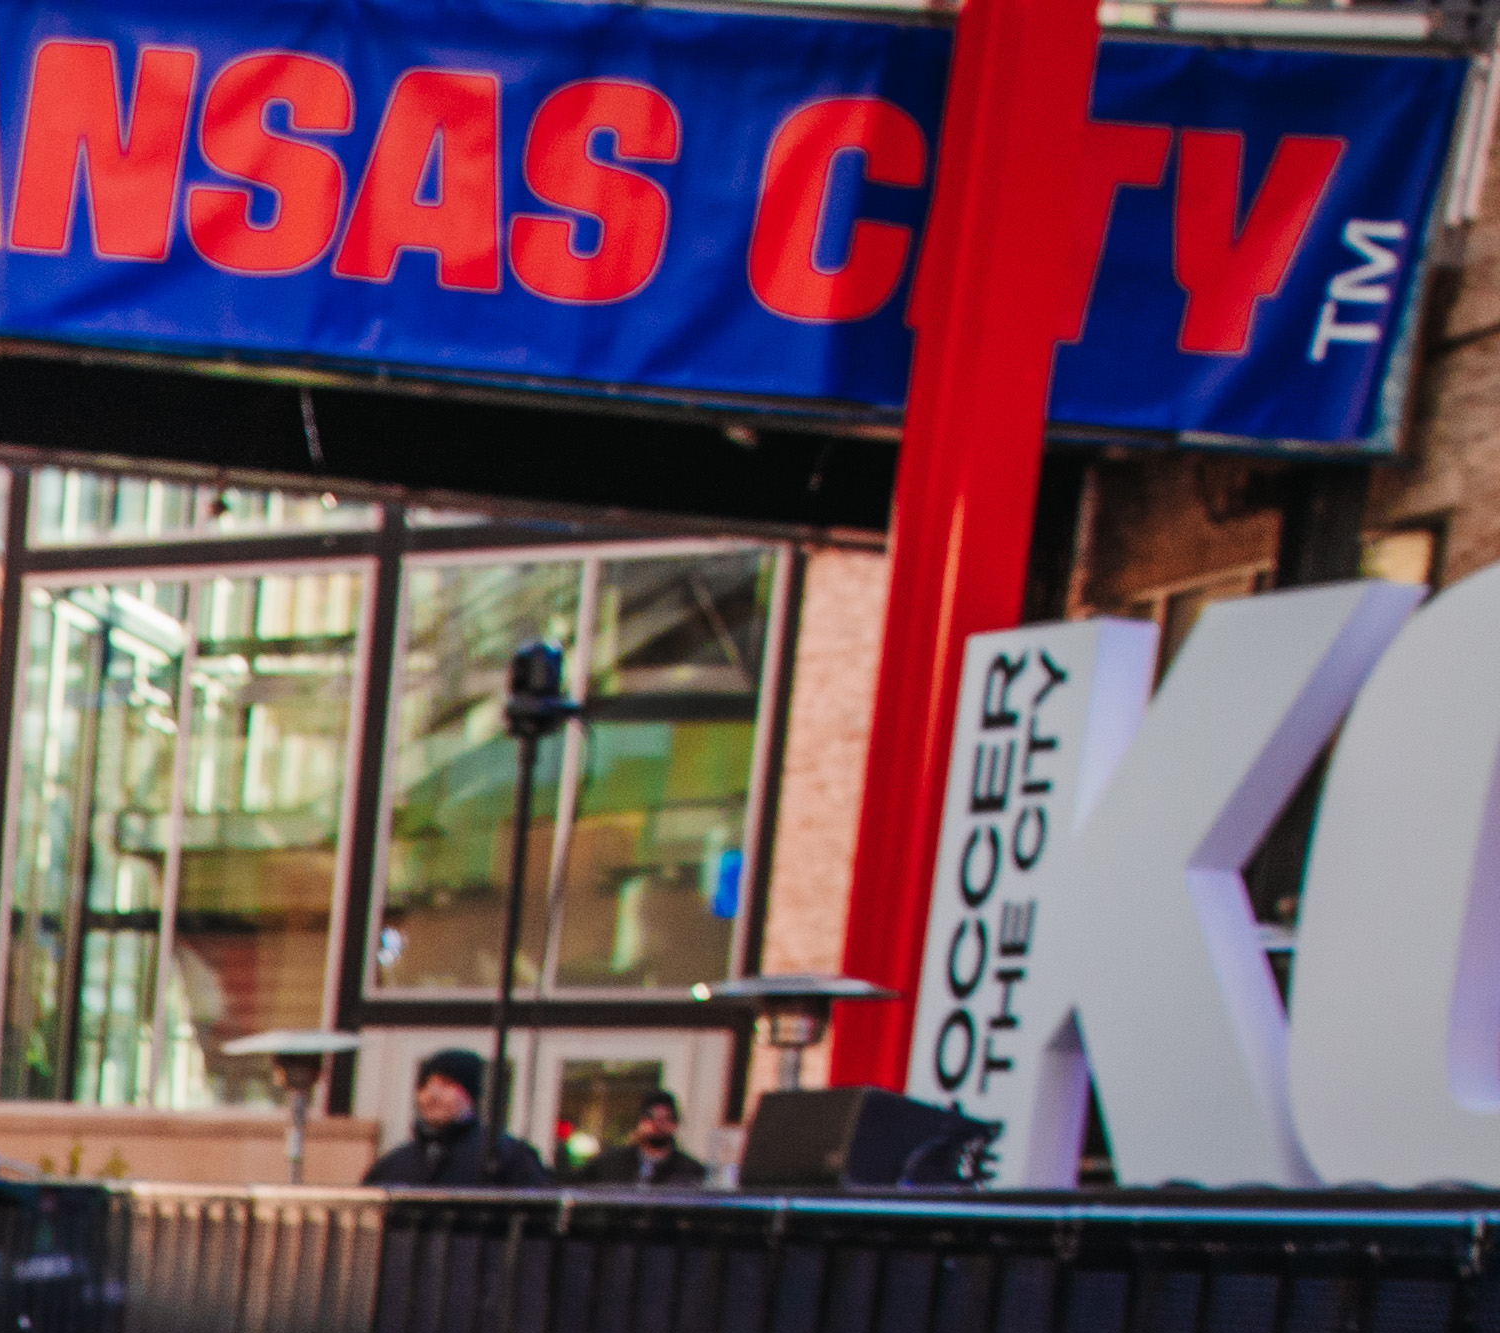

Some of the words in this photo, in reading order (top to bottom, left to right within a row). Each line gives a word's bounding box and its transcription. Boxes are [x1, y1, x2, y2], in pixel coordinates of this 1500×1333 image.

[1308, 218, 1407, 365] TM
[1011, 644, 1069, 871] CITY
[930, 648, 1030, 1112] OCCER
